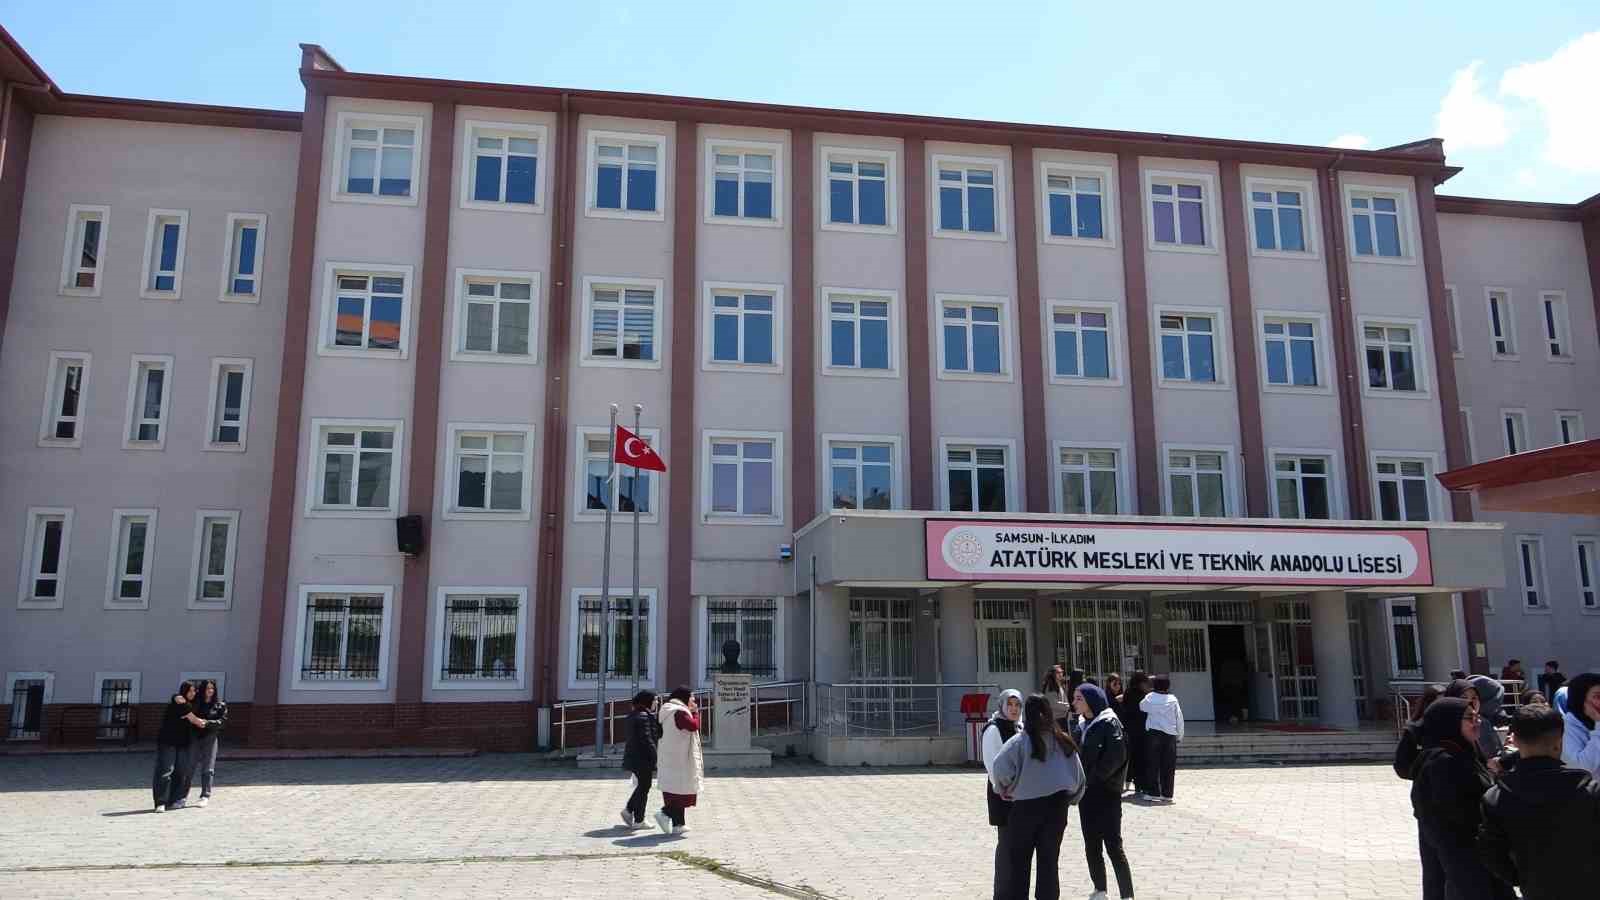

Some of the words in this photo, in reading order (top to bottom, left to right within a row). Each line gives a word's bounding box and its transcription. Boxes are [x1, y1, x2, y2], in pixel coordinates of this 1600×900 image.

[990, 547, 1078, 568] ATATÜRK
[1083, 549, 1165, 570] MESLEKİ
[1169, 553, 1194, 570] VE
[1198, 551, 1265, 571] TEKNİK
[1270, 554, 1343, 573] ANADOLU
[1348, 553, 1402, 574] LİSESİ
